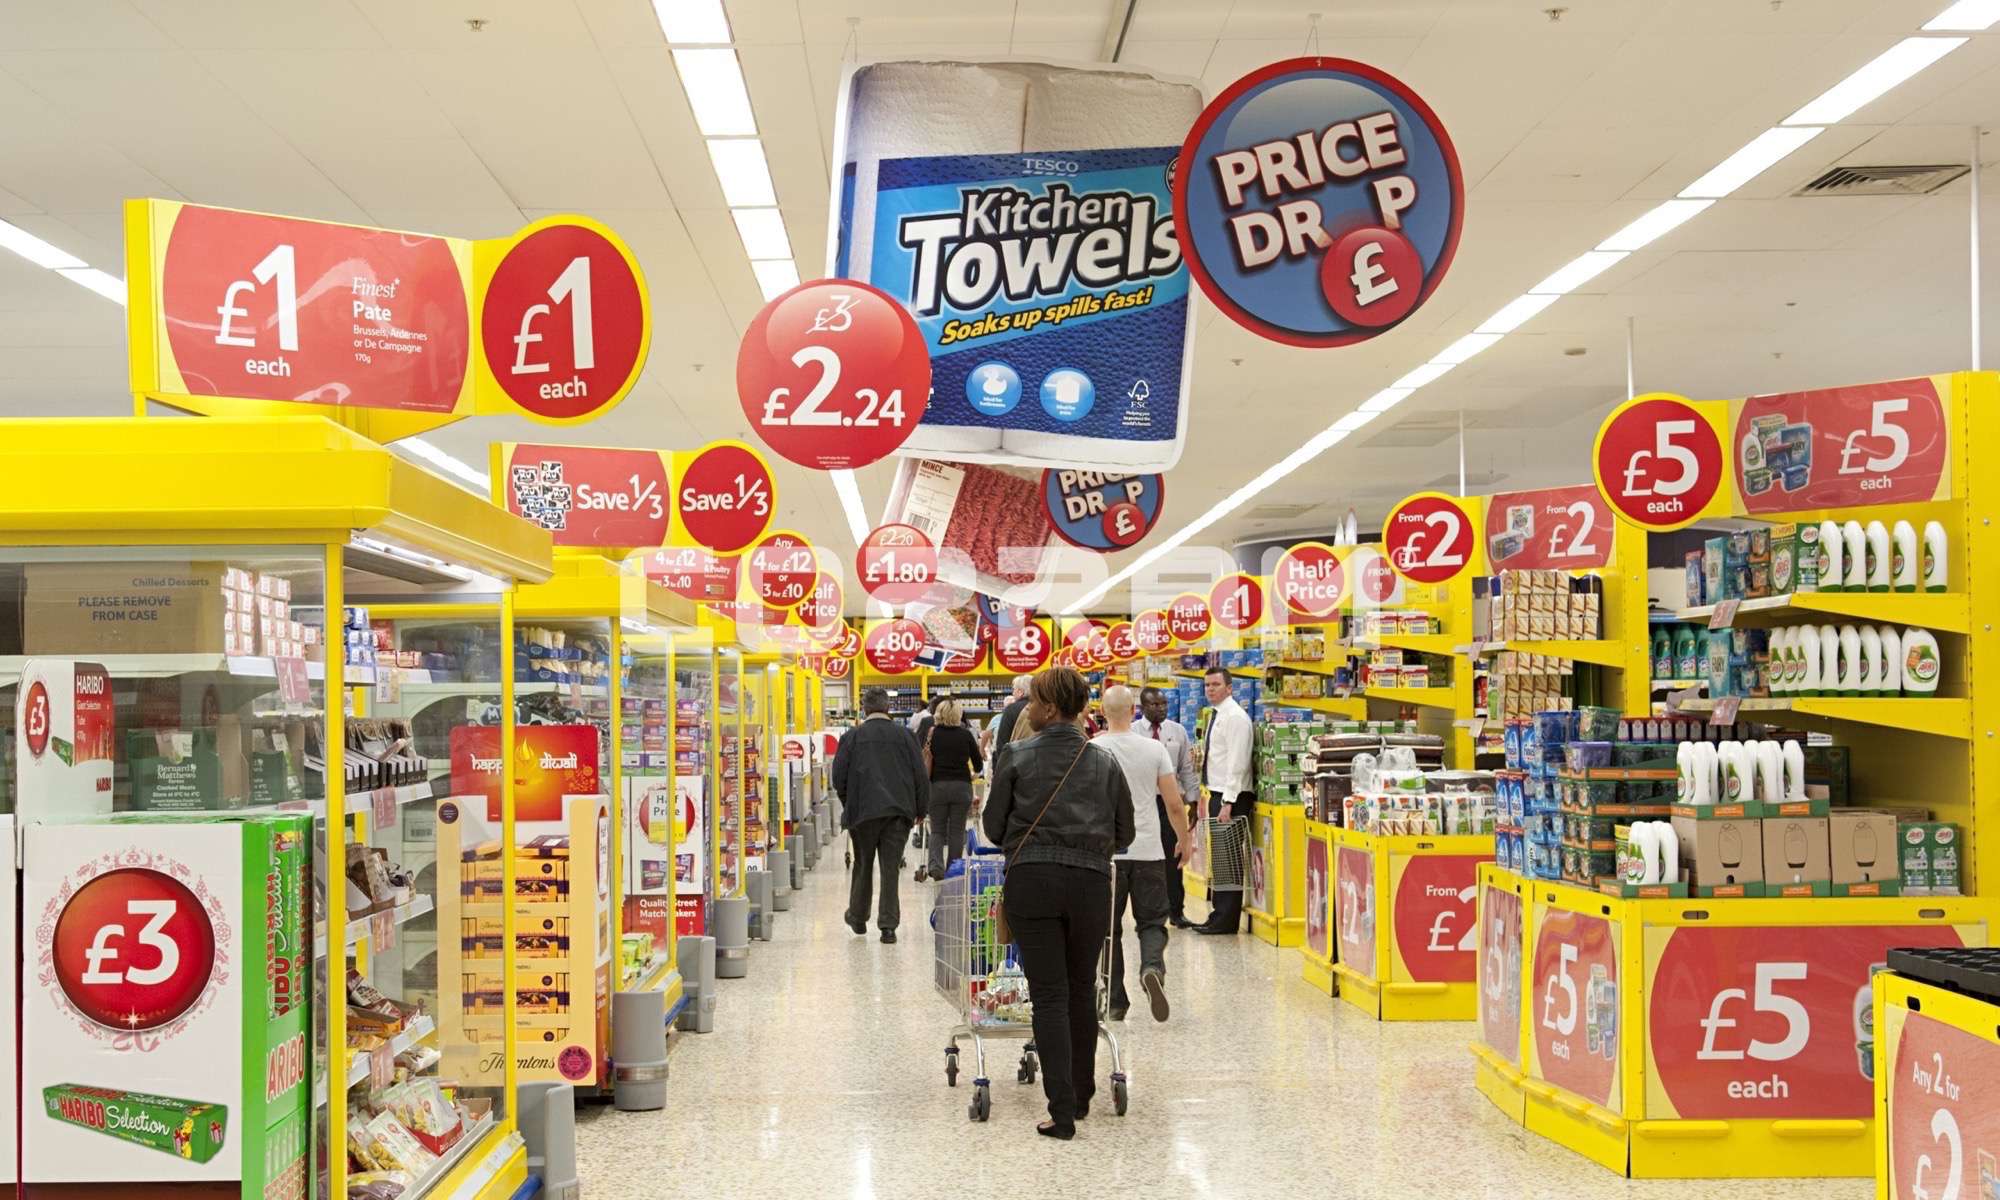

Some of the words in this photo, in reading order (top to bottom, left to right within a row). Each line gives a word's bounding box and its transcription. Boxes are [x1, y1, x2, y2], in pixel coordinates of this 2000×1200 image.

[1022, 157, 1079, 173] TESCO
[1215, 112, 1405, 206] PRICE
[963, 185, 1131, 239] Kitchen
[904, 201, 1180, 313] Towels
[215, 244, 299, 351] £1
[352, 276, 397, 298] Finest
[353, 300, 392, 322] Pate
[511, 256, 595, 375] £1
[940, 312, 1010, 345] Soaks
[1014, 308, 1043, 331] up
[1043, 297, 1101, 325] spills
[1102, 286, 1154, 311] fast!
[353, 339, 363, 348] or
[365, 338, 377, 349] De
[245, 356, 291, 378] each
[539, 376, 588, 399] each
[761, 345, 906, 427] £2.24
[1838, 398, 1910, 475] £5
[920, 459, 944, 475] MINCE
[1622, 419, 1700, 497] £5
[1860, 475, 1893, 490] each
[576, 484, 629, 510] Save
[682, 487, 735, 512] Save
[1646, 497, 1684, 514] each
[1398, 513, 1424, 524] From
[1546, 505, 1567, 514] From
[1402, 510, 1463, 568] £2
[1548, 501, 1596, 559] £2
[774, 537, 794, 550] Any
[752, 550, 766, 571] 4
[768, 560, 780, 571] for
[782, 551, 812, 572] £12
[865, 551, 928, 583] £1.80
[1288, 559, 1335, 580] Half
[132, 577, 167, 588] Chilled
[168, 577, 209, 588] Desserts
[778, 574, 788, 582] or
[1367, 567, 1392, 578] FROM
[78, 596, 120, 607] PLEASE
[123, 596, 171, 607] REMOVE
[763, 583, 771, 597] 3
[782, 583, 803, 598] £10
[812, 583, 834, 599] alf
[1220, 584, 1250, 618] £1
[1285, 581, 1339, 601] Price
[92, 610, 125, 621] FROM
[128, 610, 158, 621] CASE
[799, 600, 837, 617] Price
[1174, 603, 1205, 619] Half
[1140, 620, 1166, 631] Half
[1172, 620, 1208, 633] Price
[888, 631, 922, 651] 80p
[1003, 626, 1042, 656] £8
[1114, 628, 1136, 652] £3
[1139, 633, 1170, 644] Price
[76, 675, 104, 695] HARIBO
[29, 695, 46, 736] £3
[157, 764, 191, 772] Bernard
[470, 753, 503, 776] happ
[539, 751, 578, 769] diwali
[657, 794, 678, 804] Hf
[653, 806, 680, 816] Prie
[1426, 885, 1457, 897] From
[640, 909, 696, 918] Matchakers
[81, 899, 180, 986] £3
[1543, 942, 1578, 1036] £5
[1696, 961, 1810, 1062] £5
[1552, 1040, 1570, 1061] each
[266, 1032, 305, 1104] ARIBO
[479, 1051, 556, 1073] Thrntons
[1727, 1074, 1789, 1099] each
[1912, 1060, 1932, 1095] Any
[1933, 1051, 1944, 1095] 2
[1945, 1075, 1961, 1102] for
[59, 1095, 106, 1129] HARIBO
[106, 1105, 170, 1136] Selection
